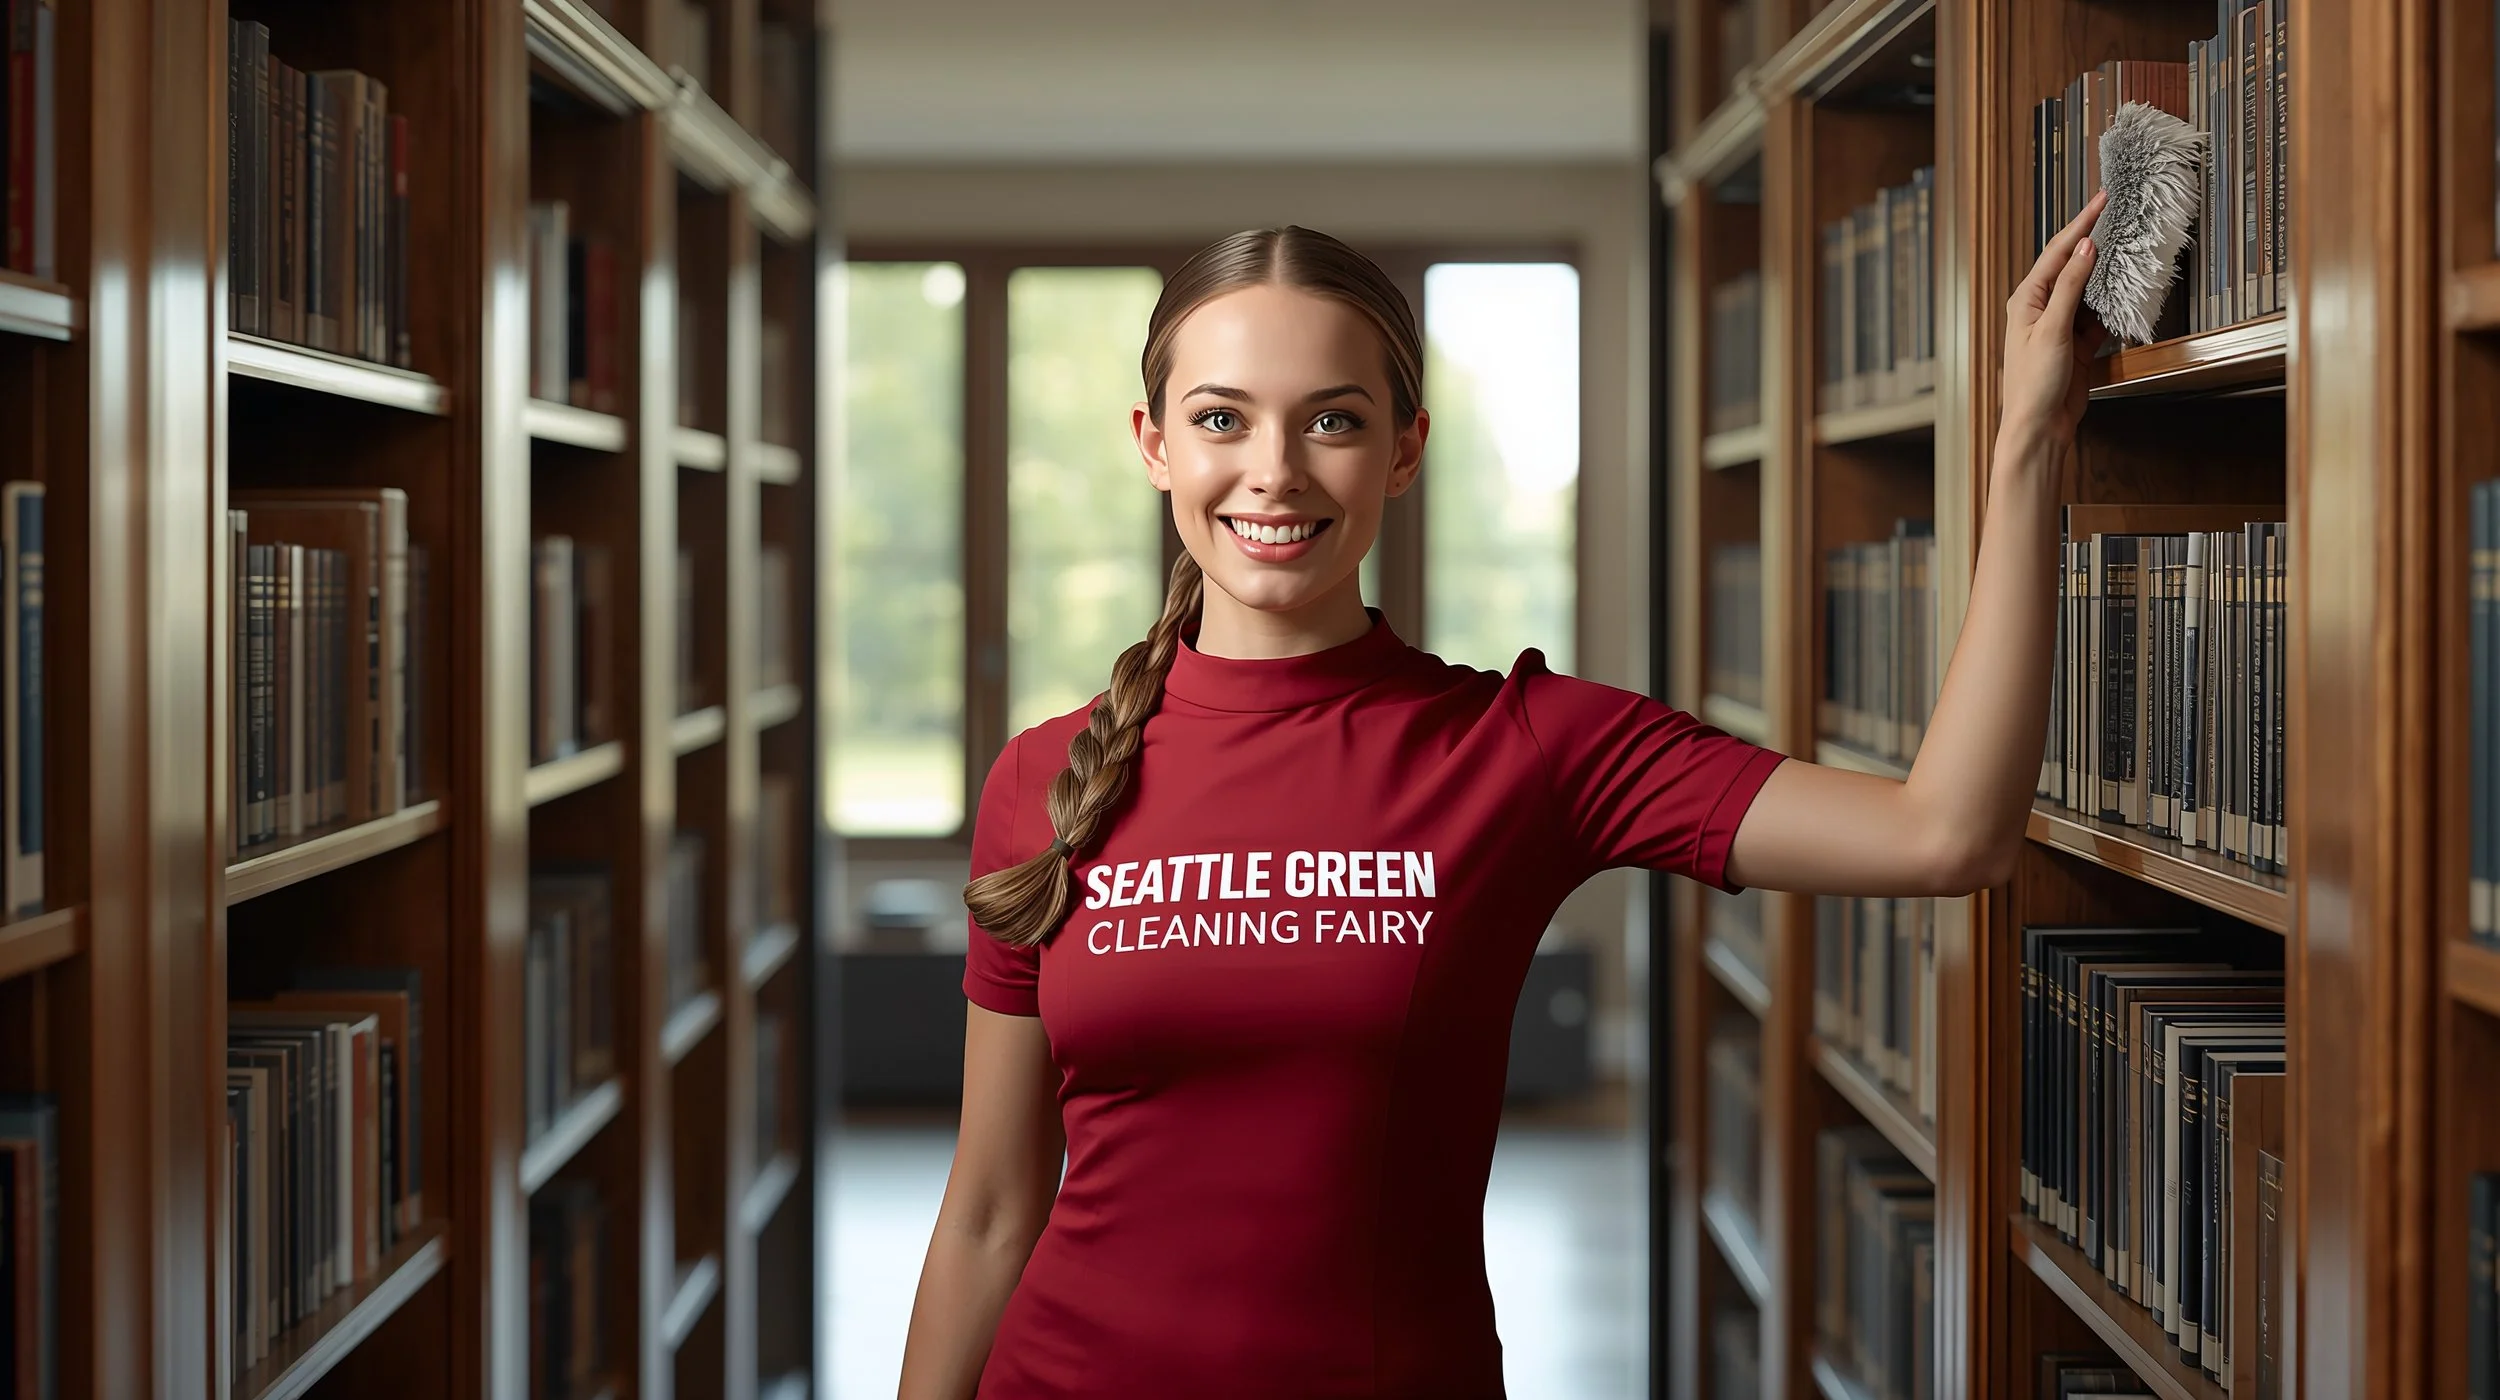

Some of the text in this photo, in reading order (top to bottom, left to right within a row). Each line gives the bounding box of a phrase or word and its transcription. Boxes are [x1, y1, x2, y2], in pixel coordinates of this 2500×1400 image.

[1085, 850, 1436, 910] SEATTLE GREEN
[1087, 910, 1434, 955] CLEANING FAIRY
